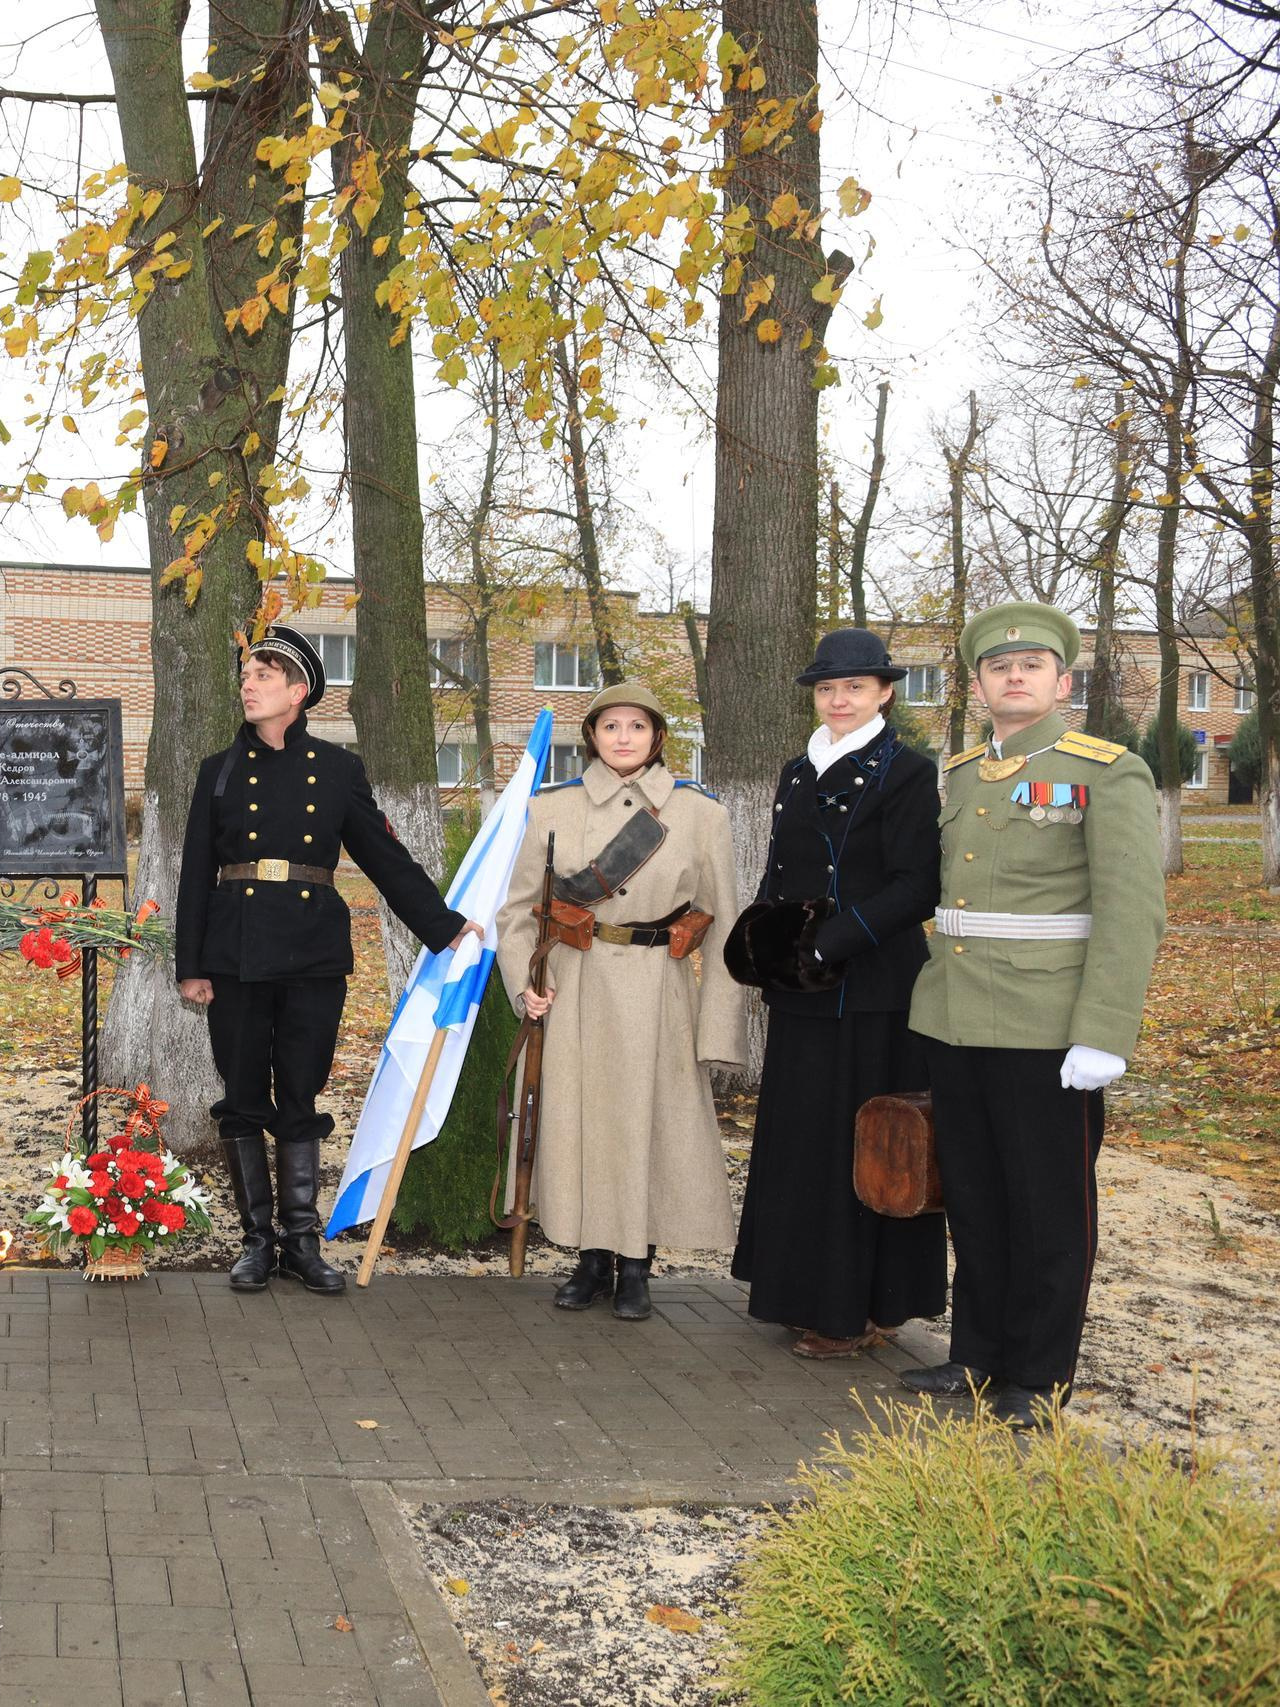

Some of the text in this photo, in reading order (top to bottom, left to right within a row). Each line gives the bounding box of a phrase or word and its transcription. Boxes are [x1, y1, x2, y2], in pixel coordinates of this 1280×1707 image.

[6, 717, 65, 730] Отечеству
[0, 775, 78, 787] Александрович
[23, 792, 47, 802] 1945
